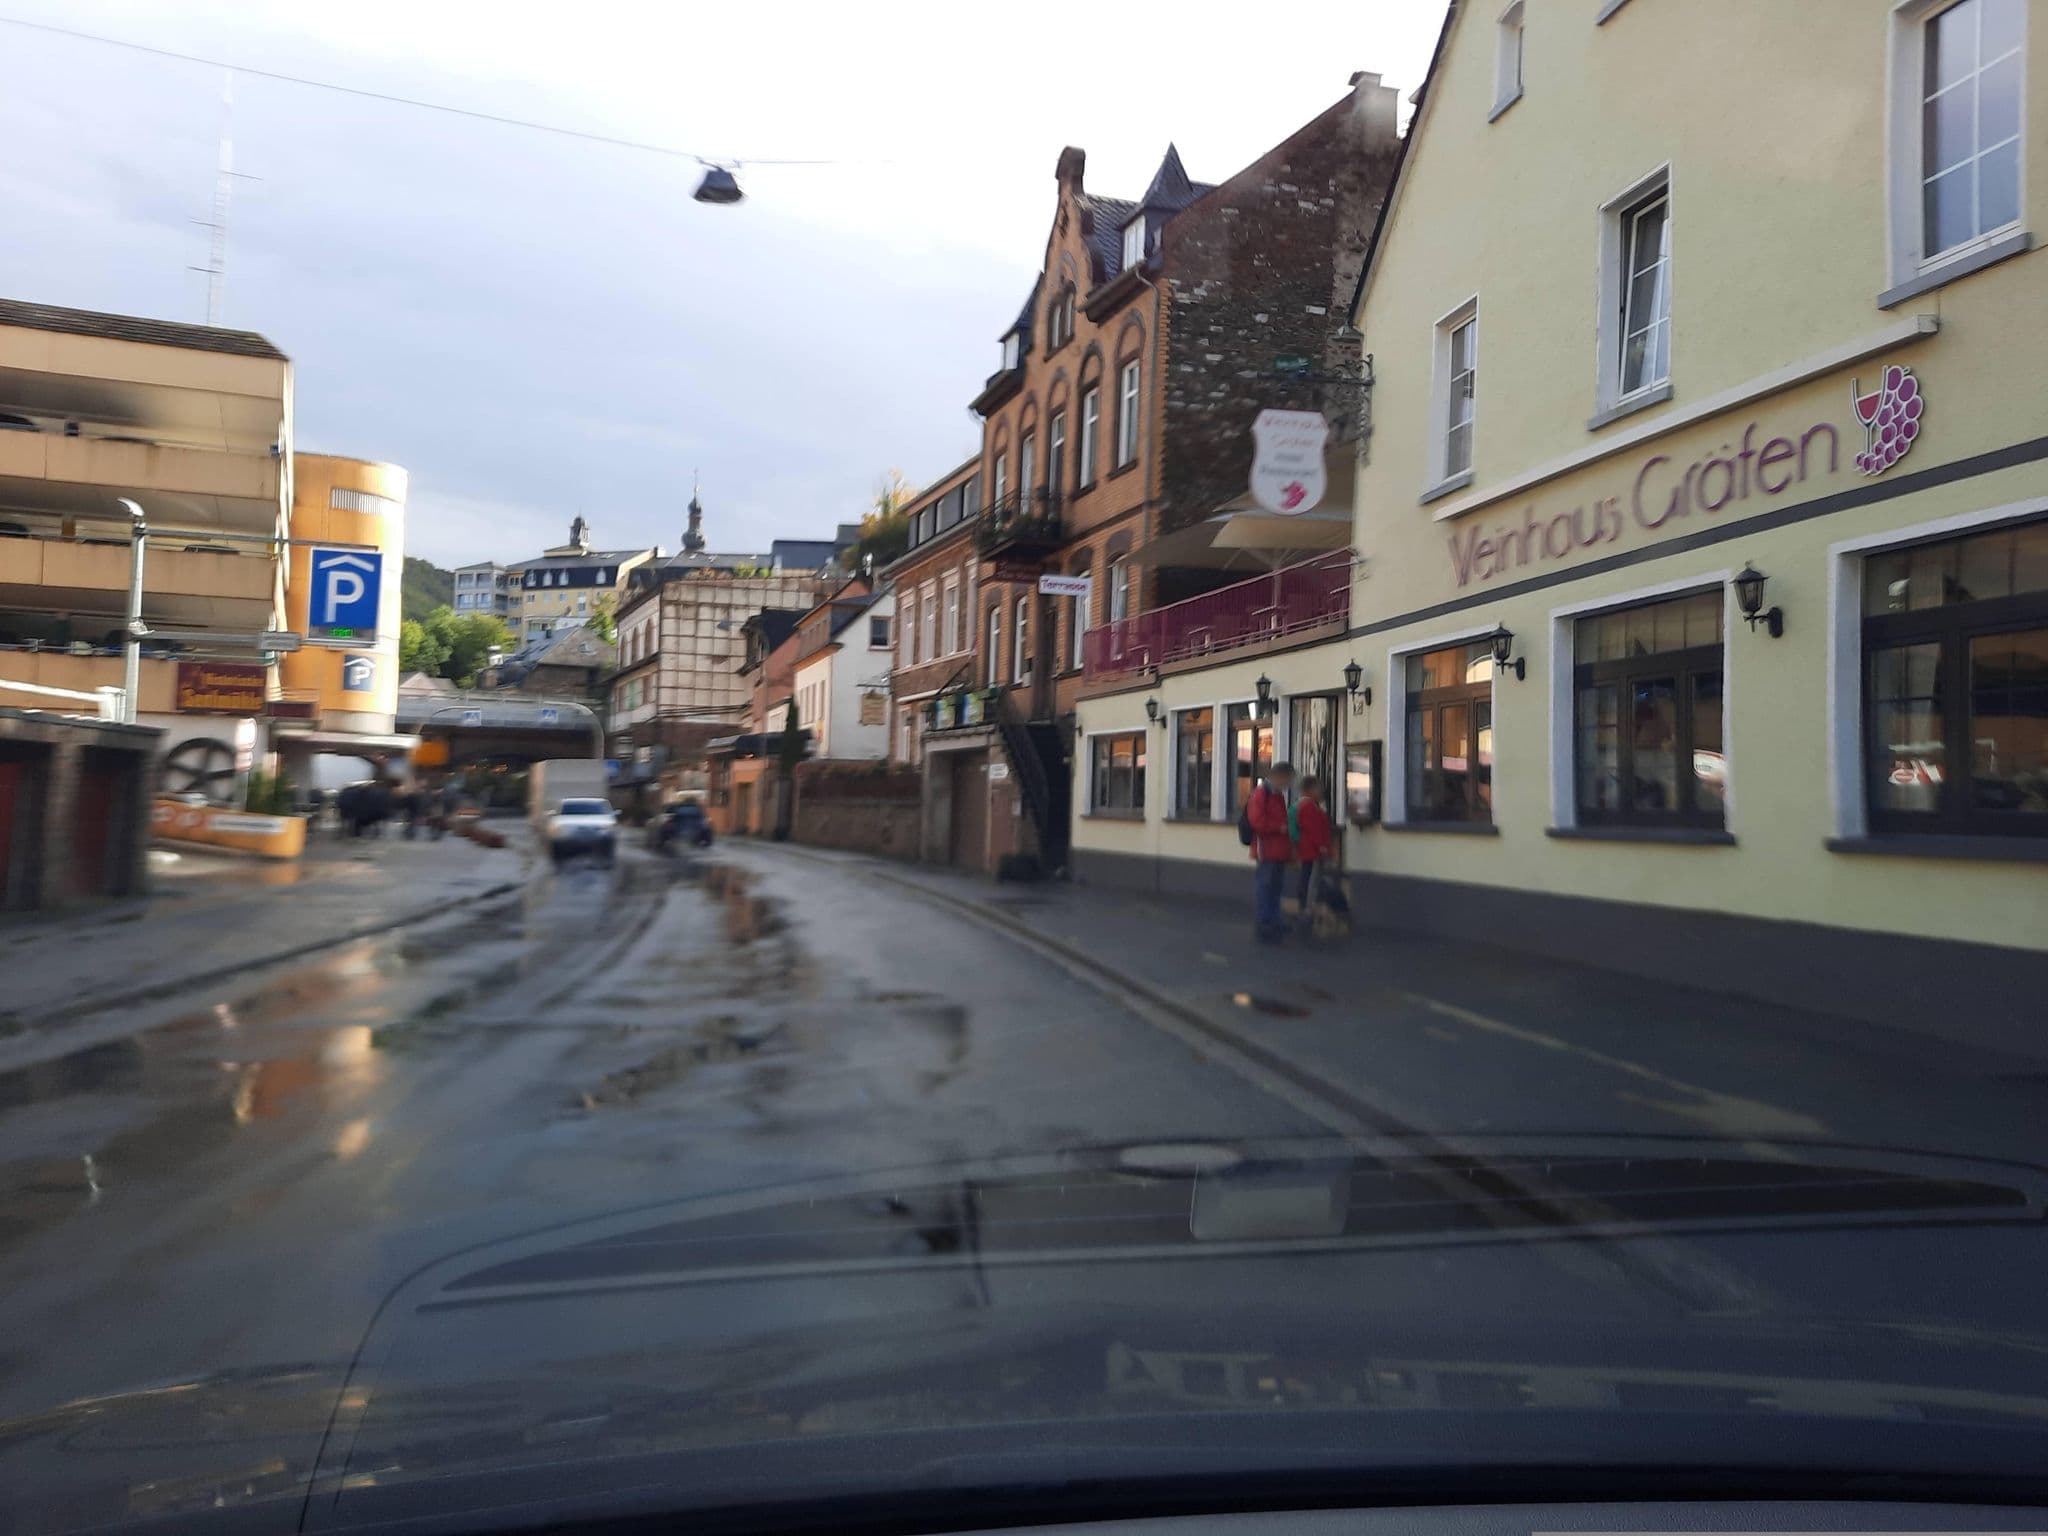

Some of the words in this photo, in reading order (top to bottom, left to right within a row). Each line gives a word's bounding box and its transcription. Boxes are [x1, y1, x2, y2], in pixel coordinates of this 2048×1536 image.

[1632, 421, 1839, 529] Gräfen
[324, 571, 365, 622] P
[352, 666, 371, 685] P
